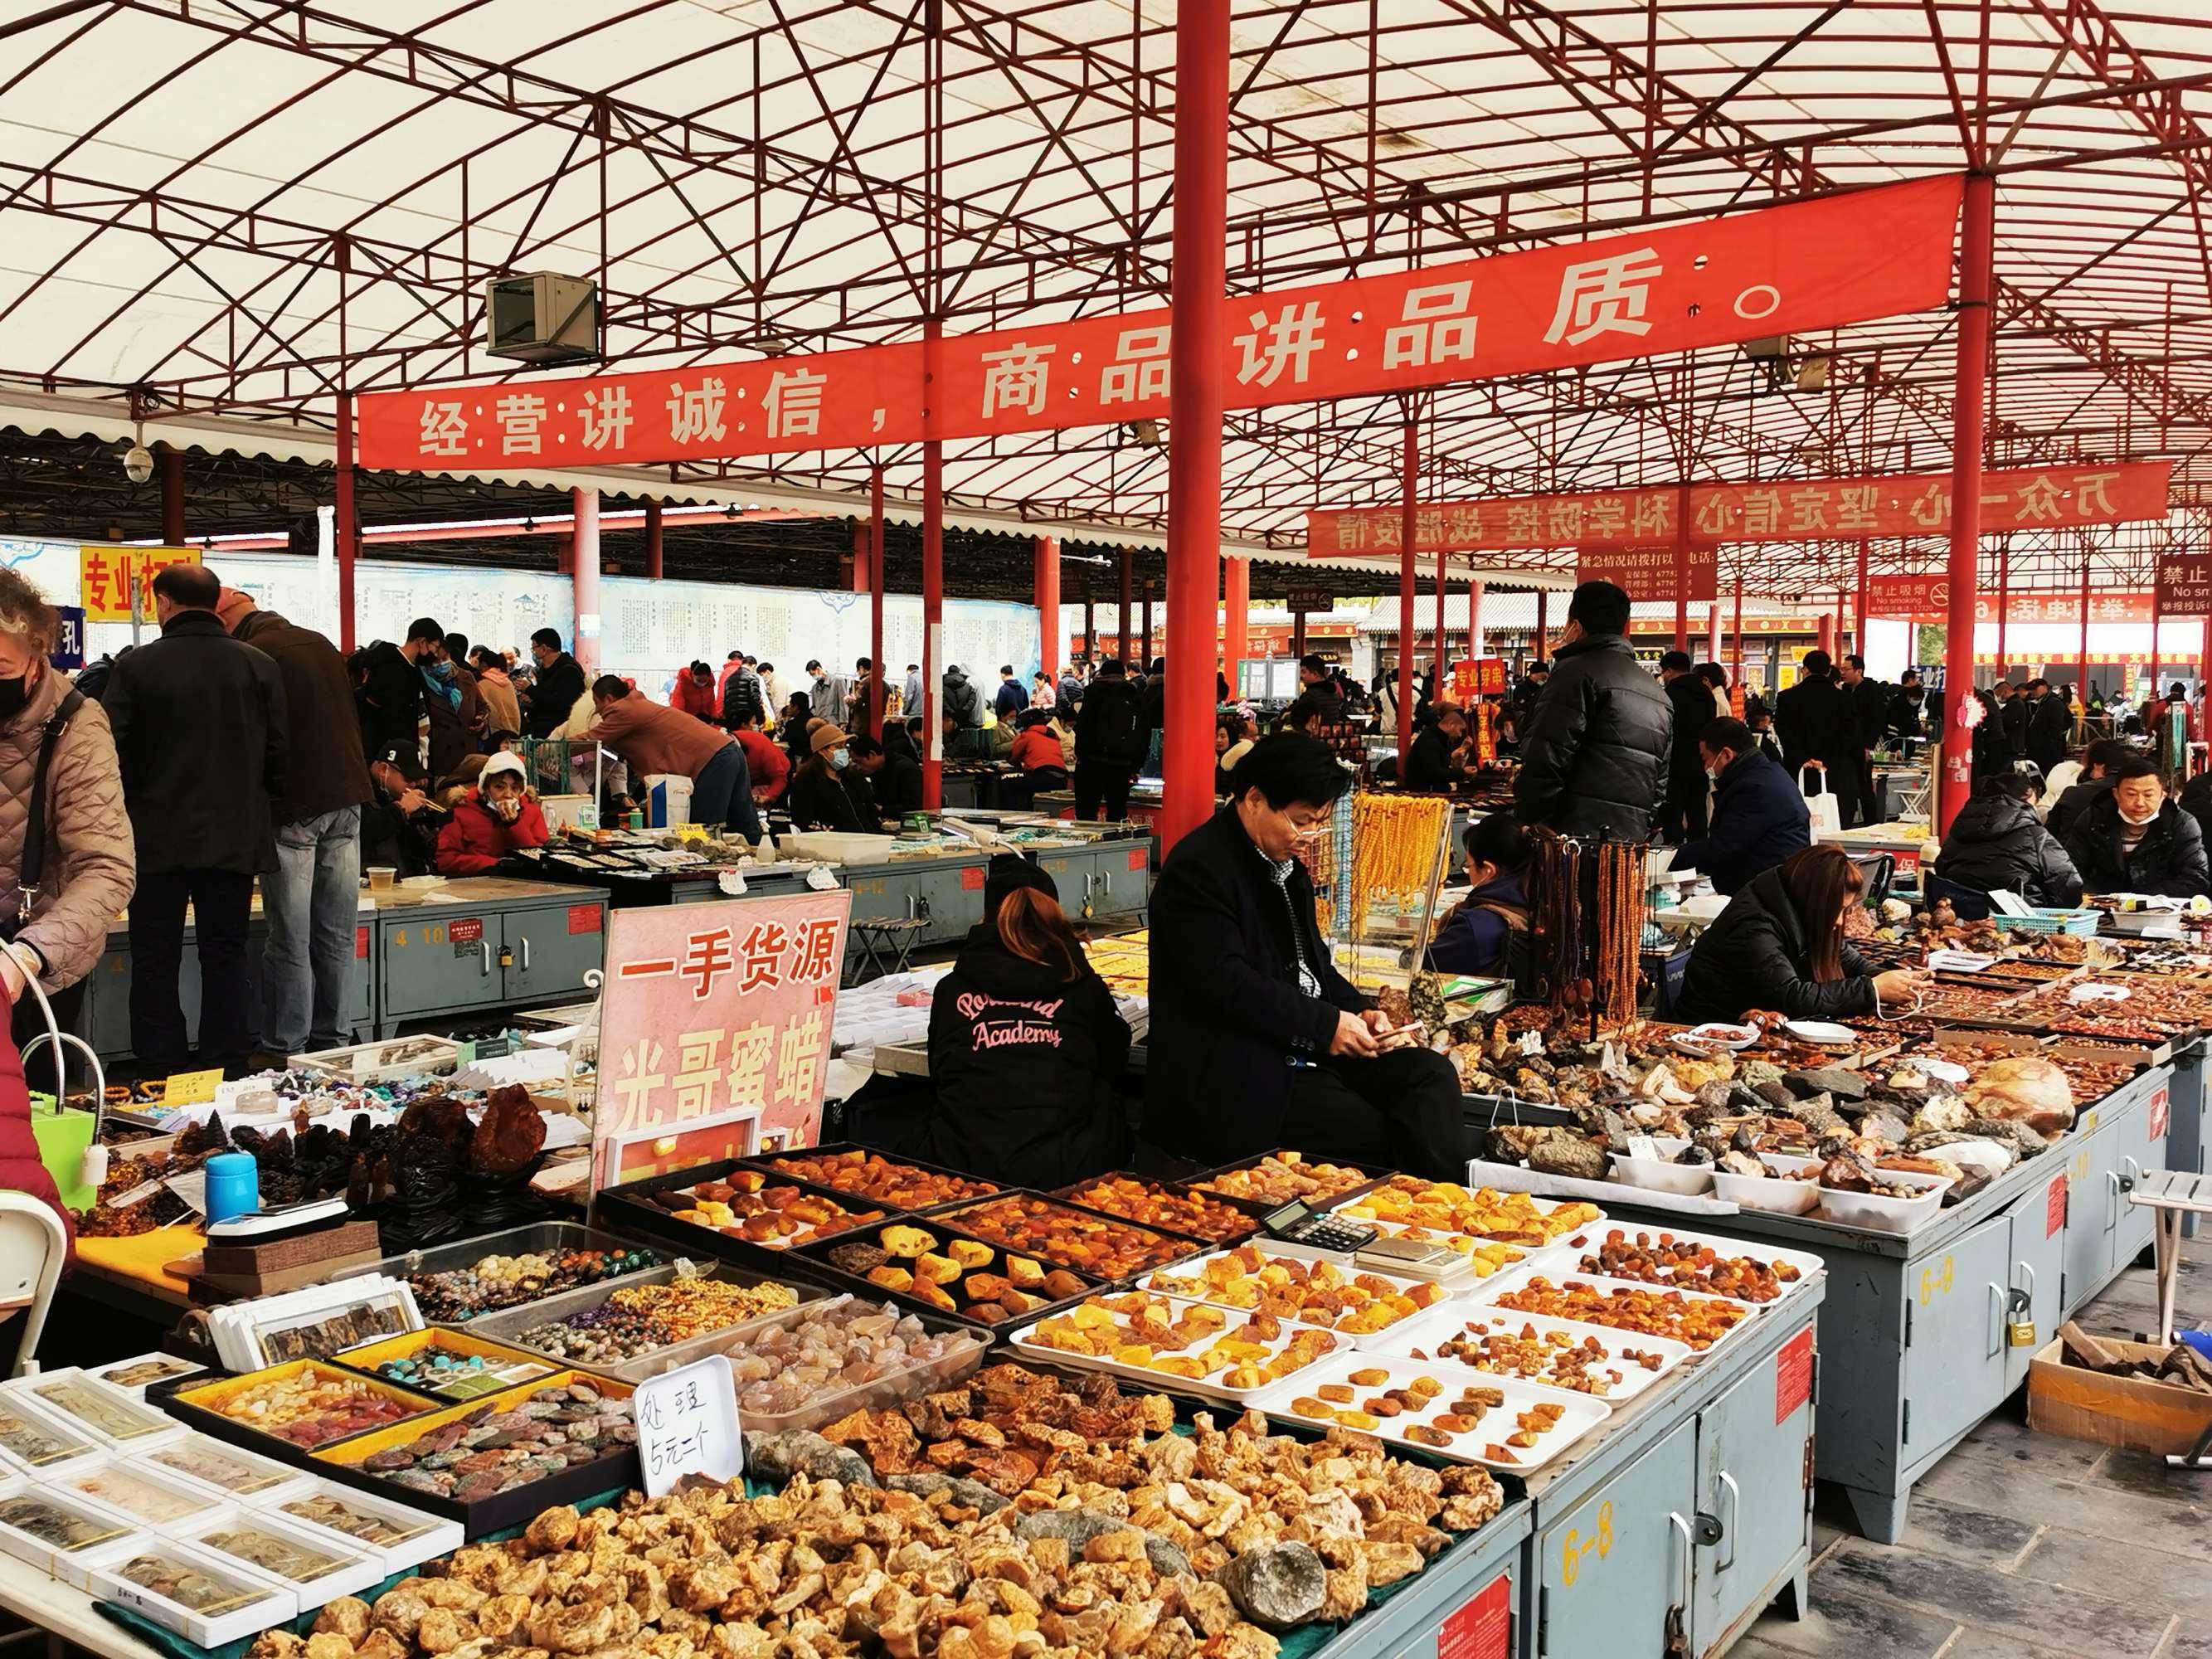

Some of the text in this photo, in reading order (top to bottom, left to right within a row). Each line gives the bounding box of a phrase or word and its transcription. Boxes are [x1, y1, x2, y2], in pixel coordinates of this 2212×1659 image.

[1581, 551, 1715, 568] 紧急情况请拨打以电话：
[2163, 565, 2208, 585] 禁止
[85, 552, 191, 612] 专业打
[2173, 586, 2191, 597] No
[619, 917, 841, 1000] 一手货源
[971, 1019, 1063, 1052] Academy
[1562, 1501, 1614, 1587] 6-8
